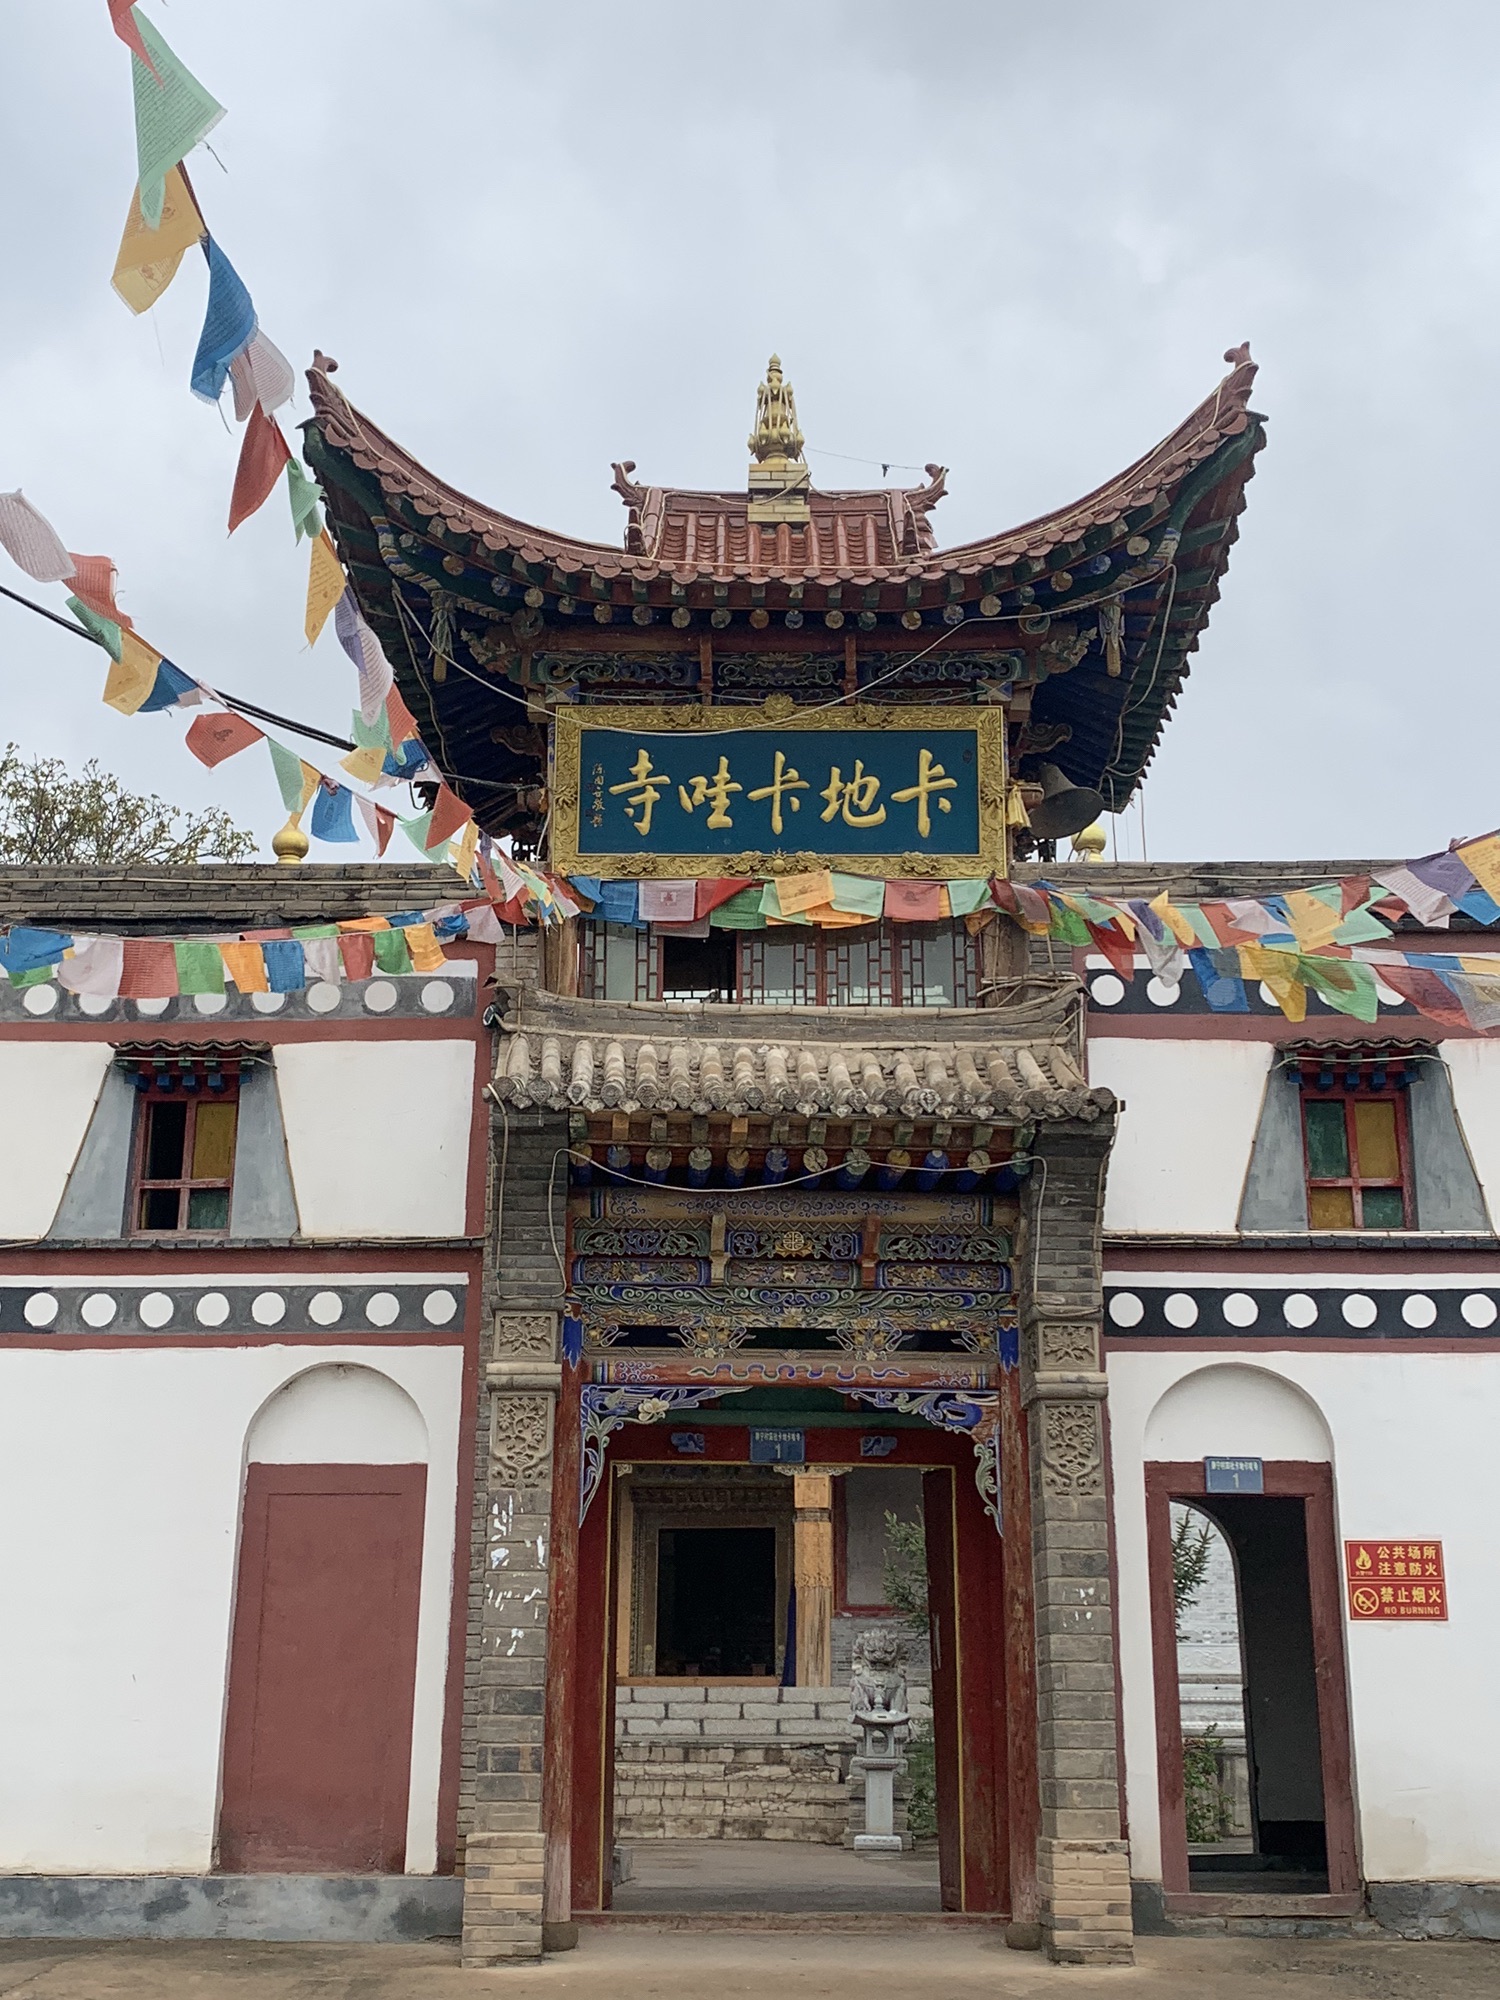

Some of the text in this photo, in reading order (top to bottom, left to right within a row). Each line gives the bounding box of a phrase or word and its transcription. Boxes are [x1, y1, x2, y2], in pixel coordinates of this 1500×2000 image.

[609, 748, 959, 838] 卡地卡哇寺
[775, 1443, 781, 1458] 1
[1232, 1472, 1240, 1488] 1
[1377, 1546, 1436, 1559] 公共场所
[1378, 1562, 1438, 1576] 注意防火
[1380, 1586, 1441, 1603] 禁止烟火
[1384, 1606, 1440, 1615] NO BURNING
